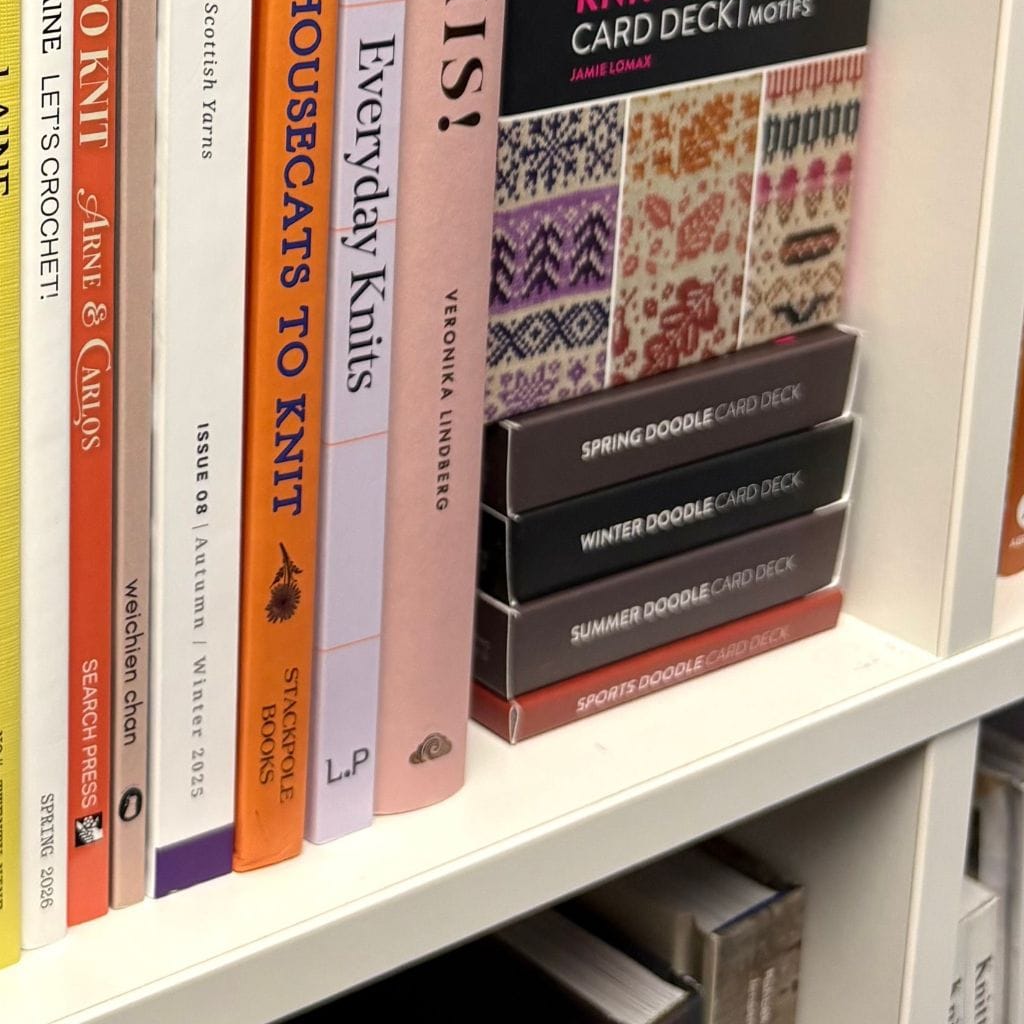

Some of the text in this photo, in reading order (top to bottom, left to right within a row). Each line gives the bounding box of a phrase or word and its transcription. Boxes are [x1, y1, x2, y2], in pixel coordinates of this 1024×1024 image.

[202, 3, 219, 91] Scottish
[570, 54, 652, 82] JAMIE LOMAX
[572, 12, 653, 55] CARD
[79, 48, 109, 149] KNIT
[201, 99, 216, 160] Yarns
[40, 157, 59, 300] CROCHET!
[341, 34, 395, 393] Everyday Knits
[81, 301, 107, 328] &
[277, 305, 309, 378] TO
[436, 288, 458, 511] VERONIKA LINDBERG
[581, 383, 802, 461] SPRING DOODLE CARD DECK
[196, 423, 209, 482] ISSUE
[273, 393, 306, 517] KNIT
[196, 490, 207, 515] 08
[581, 471, 803, 552] WINTER DOODLE CARD DECK
[194, 538, 208, 629] Autumn
[570, 555, 796, 645] SUMMER DOODLE CARD DECK
[123, 578, 144, 746] weichien chan
[191, 656, 207, 738] Winter
[576, 625, 791, 712] SPORTS DOODLE CARD DECK
[80, 658, 98, 810] SEARCH PRESS
[190, 747, 205, 800] 2025
[259, 703, 276, 785] BOOKS
[280, 667, 299, 804] STACKPOLE
[40, 793, 55, 910] SPRING 2026
